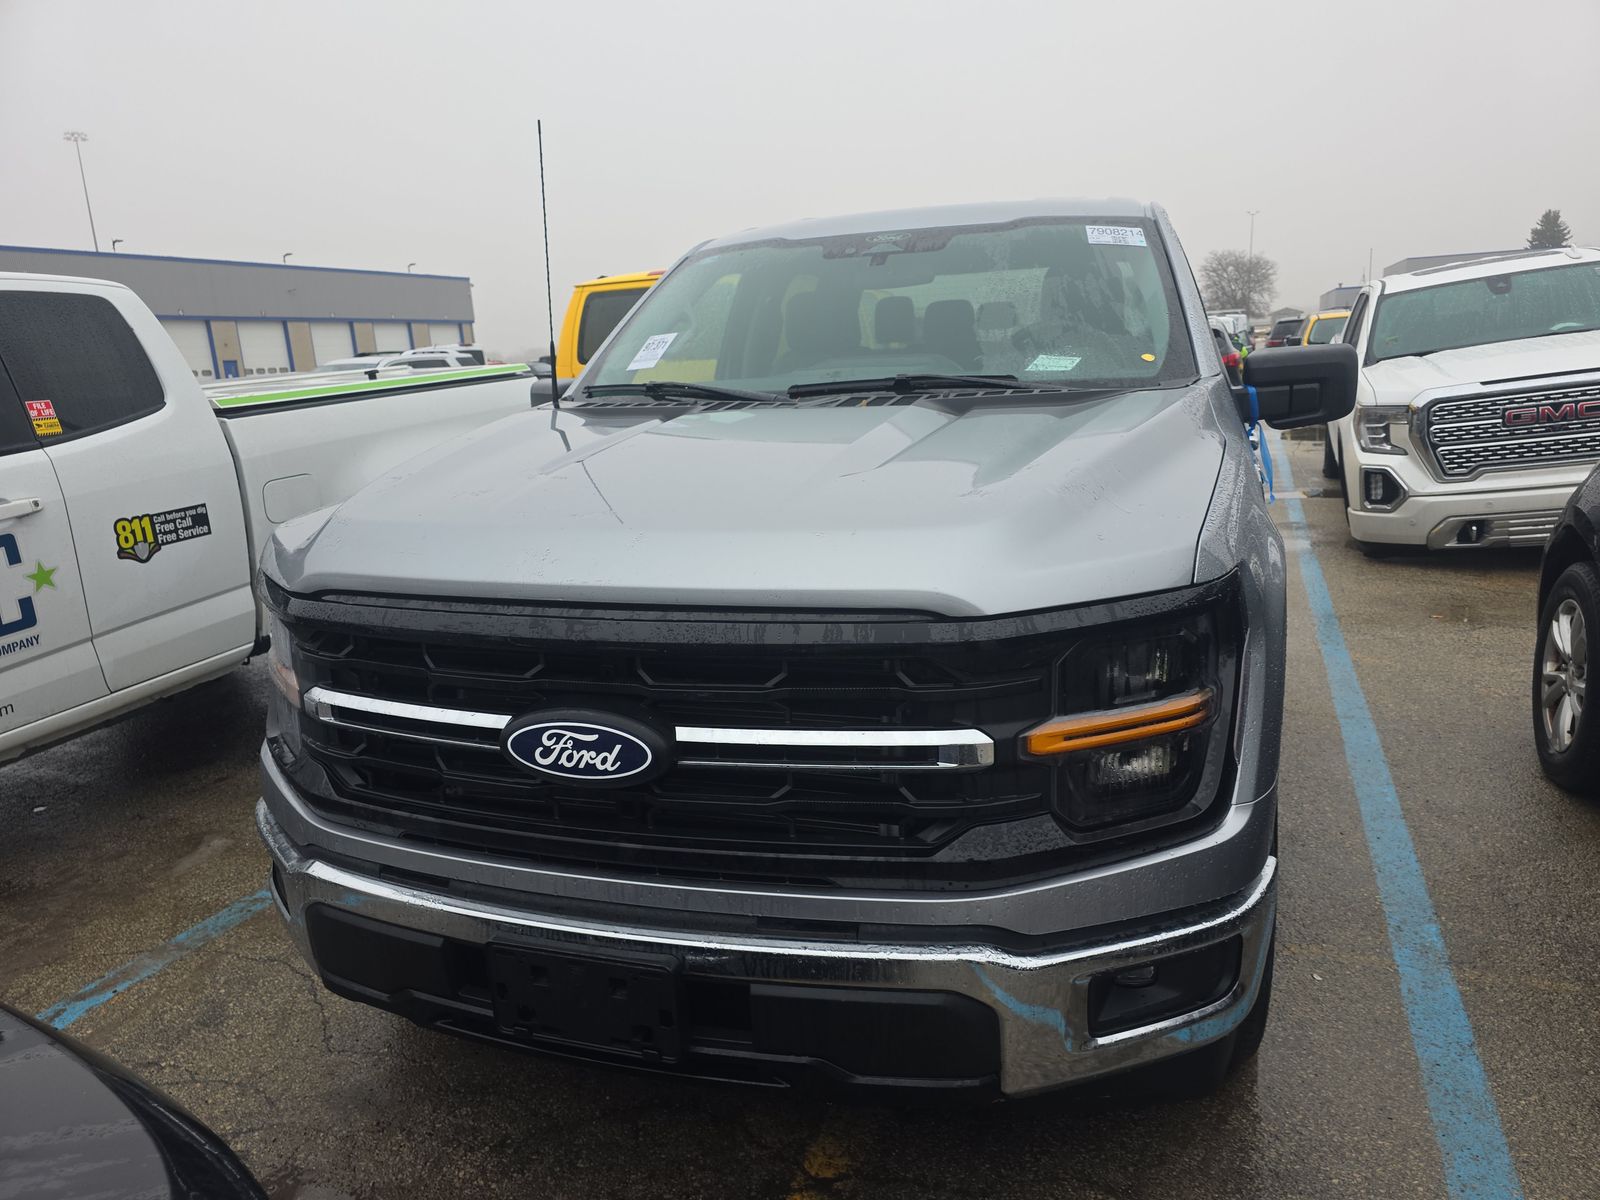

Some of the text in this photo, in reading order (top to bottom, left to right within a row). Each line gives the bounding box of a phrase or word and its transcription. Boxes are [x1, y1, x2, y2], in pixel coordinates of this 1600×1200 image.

[1088, 227, 1143, 237] 7908214
[1505, 401, 1600, 425] GMC
[153, 506, 206, 523] Call before you dig
[116, 516, 155, 549] 811
[155, 517, 192, 533] Free Call
[157, 525, 208, 544] Free Service
[534, 729, 622, 772] Ford
